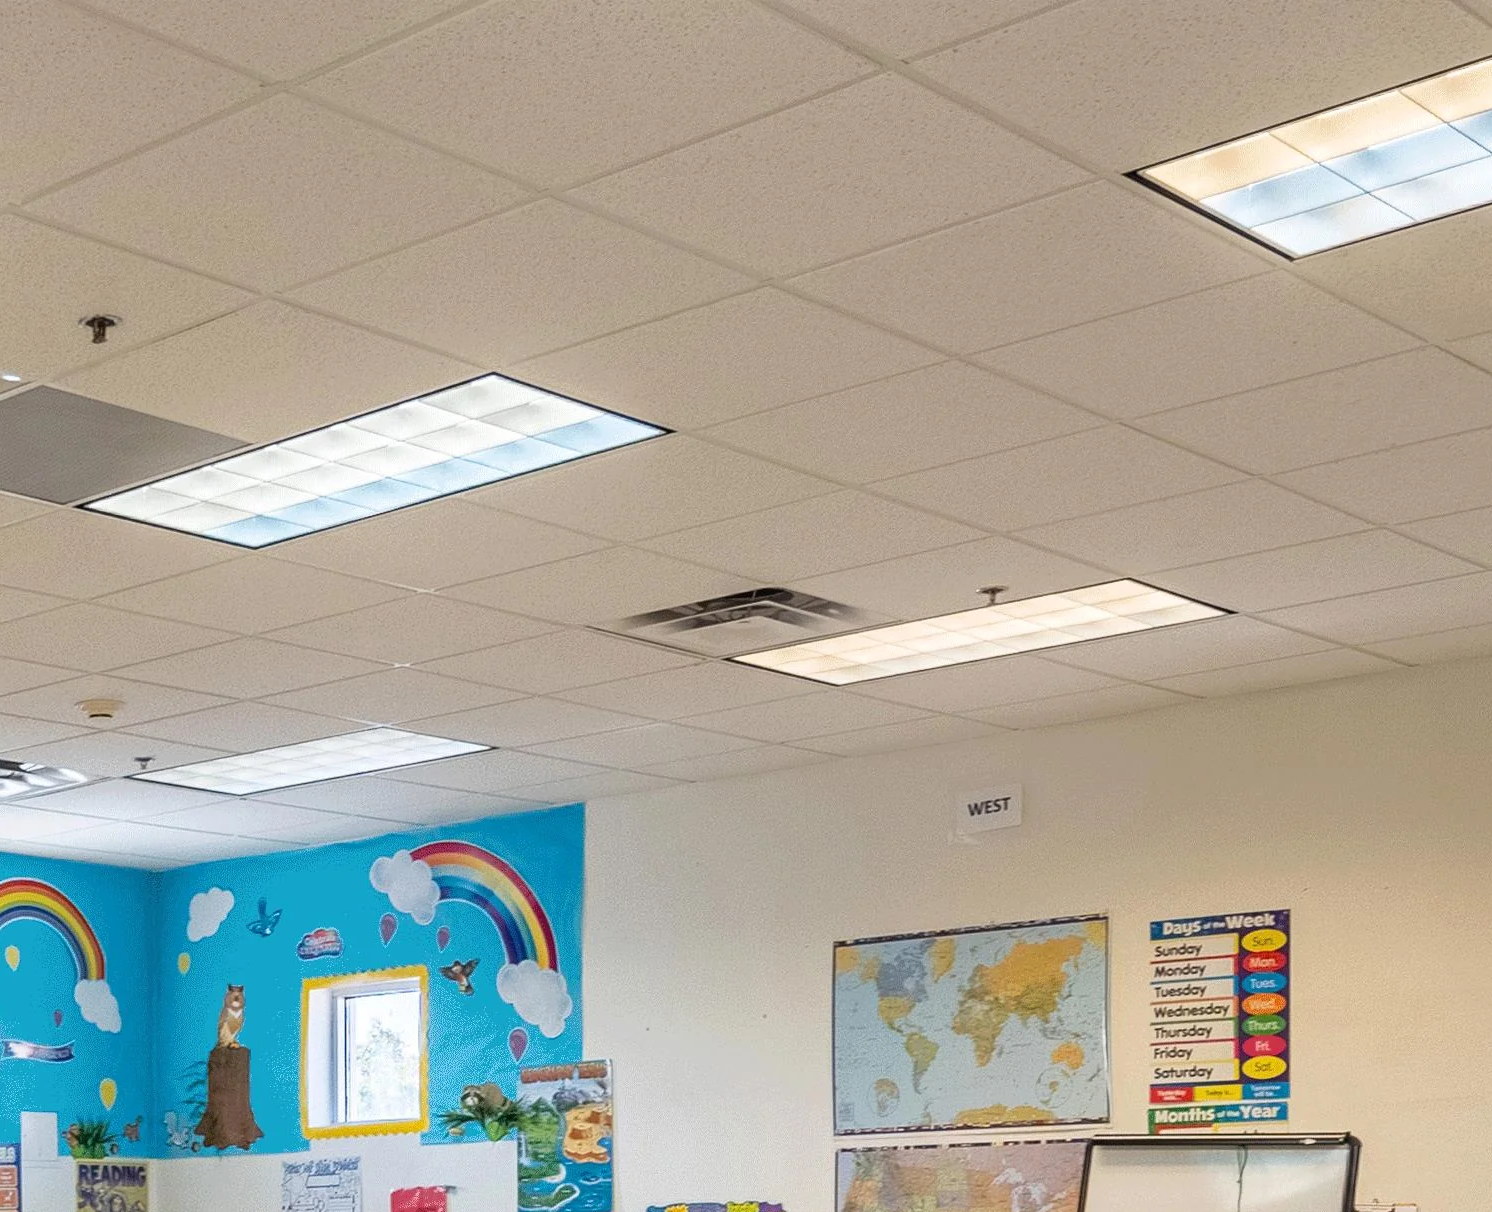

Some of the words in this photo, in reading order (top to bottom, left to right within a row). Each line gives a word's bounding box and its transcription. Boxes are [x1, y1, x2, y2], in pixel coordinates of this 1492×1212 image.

[967, 796, 1012, 817] WEST
[1163, 921, 1201, 936] Days
[1225, 914, 1276, 929] Week
[1155, 944, 1202, 957] Sunday
[1154, 965, 1206, 978] Monday
[1155, 984, 1207, 998] Tuesday
[1154, 1004, 1230, 1018] Wednesday
[1154, 1026, 1212, 1039] Thursday
[1154, 1047, 1193, 1060] Friday
[1154, 1067, 1213, 1079] Saturday
[1155, 1109, 1215, 1123] Months
[1240, 1106, 1281, 1118] Year
[79, 1165, 146, 1187] READING
